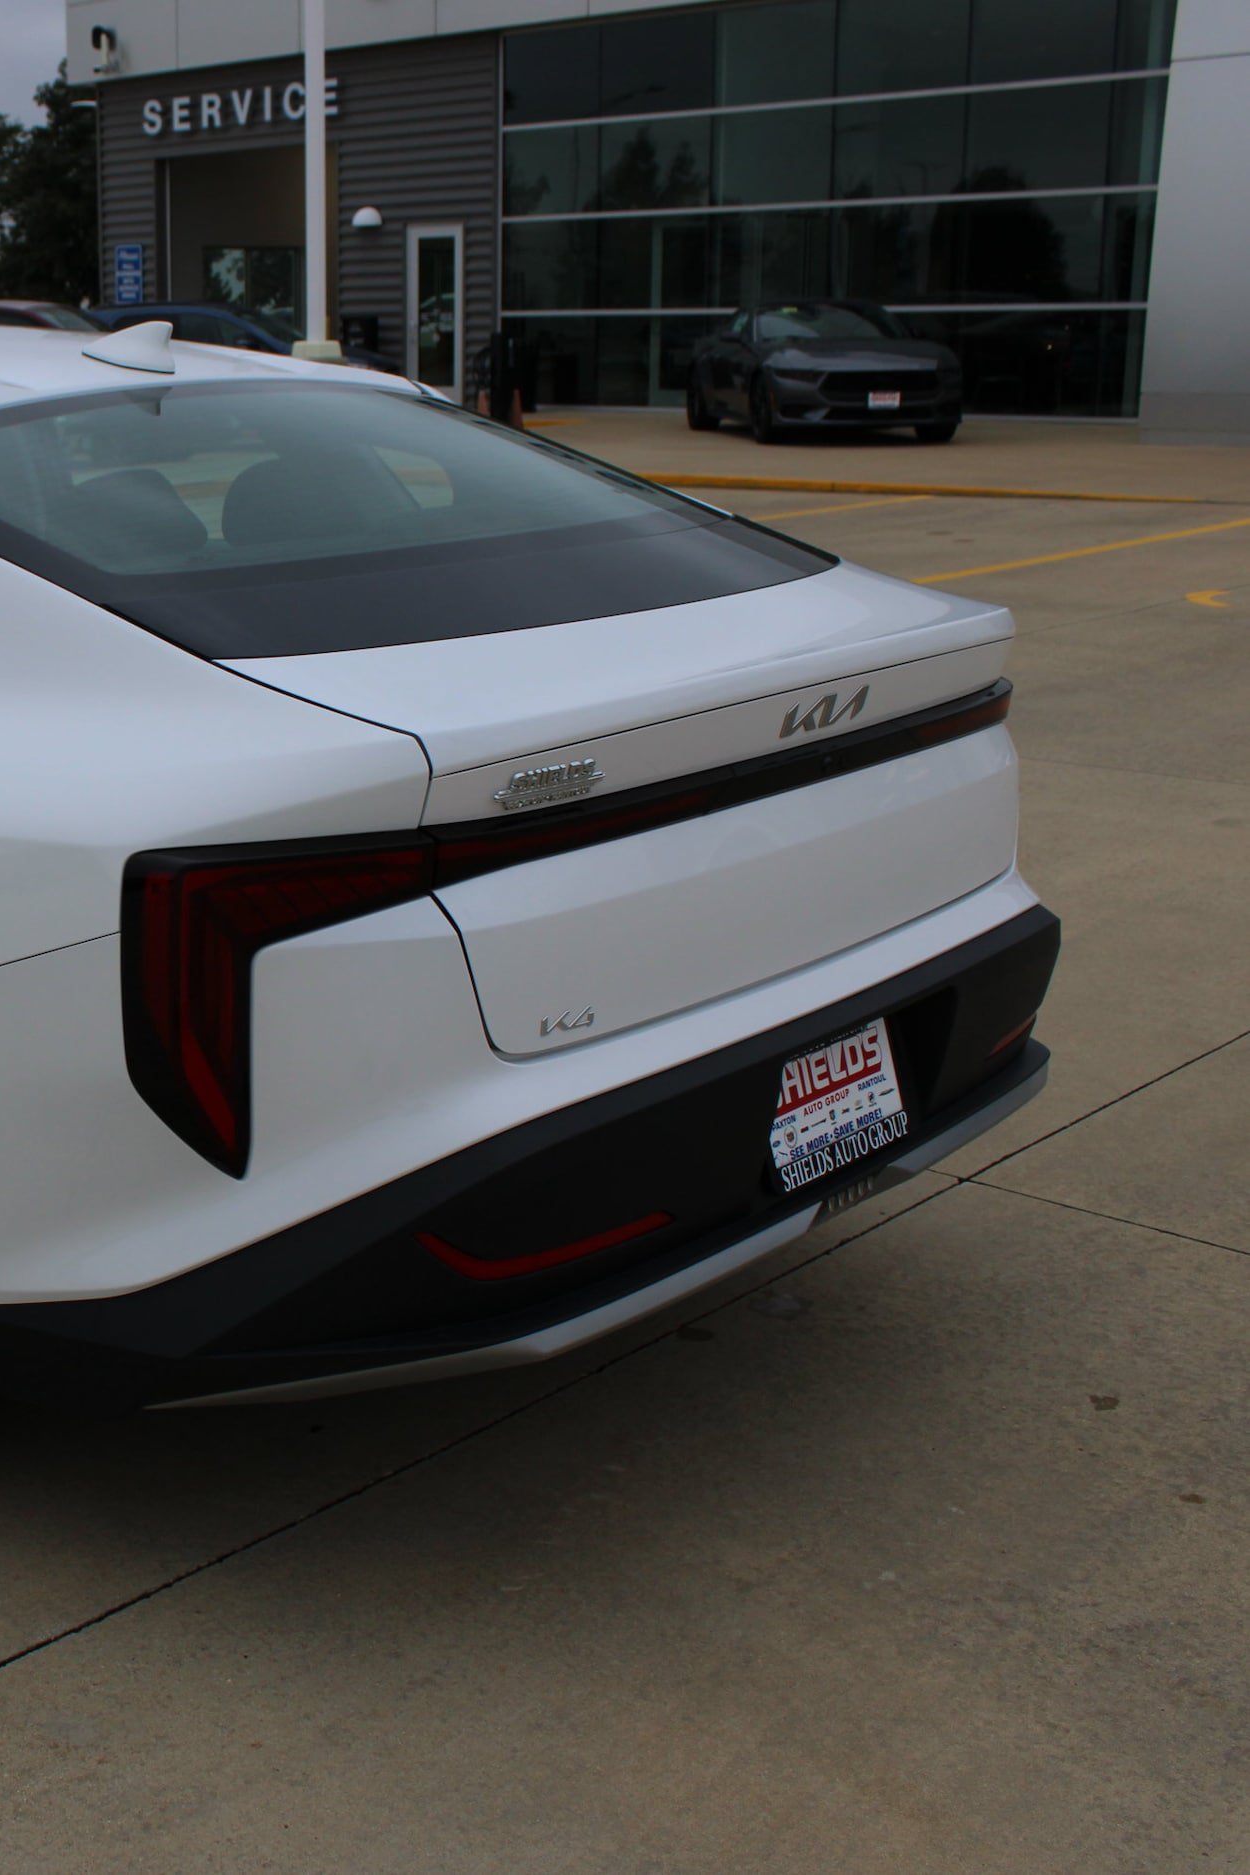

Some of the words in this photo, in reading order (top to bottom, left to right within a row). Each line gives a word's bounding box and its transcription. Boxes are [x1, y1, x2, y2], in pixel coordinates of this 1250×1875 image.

[142, 77, 338, 136] SERVICE
[779, 685, 870, 739] KIA
[510, 758, 596, 791] SHIELDS
[540, 1005, 595, 1037] K4
[803, 1101, 823, 1117] AUTO
[825, 1089, 850, 1106] GROUP
[858, 1074, 887, 1091] RANTOUL
[781, 1147, 834, 1192] SHIELDS
[835, 1132, 868, 1168] AUTO
[868, 1111, 908, 1150] GROUP
[790, 1145, 806, 1160] SEE
[856, 1108, 883, 1127] MORE!
